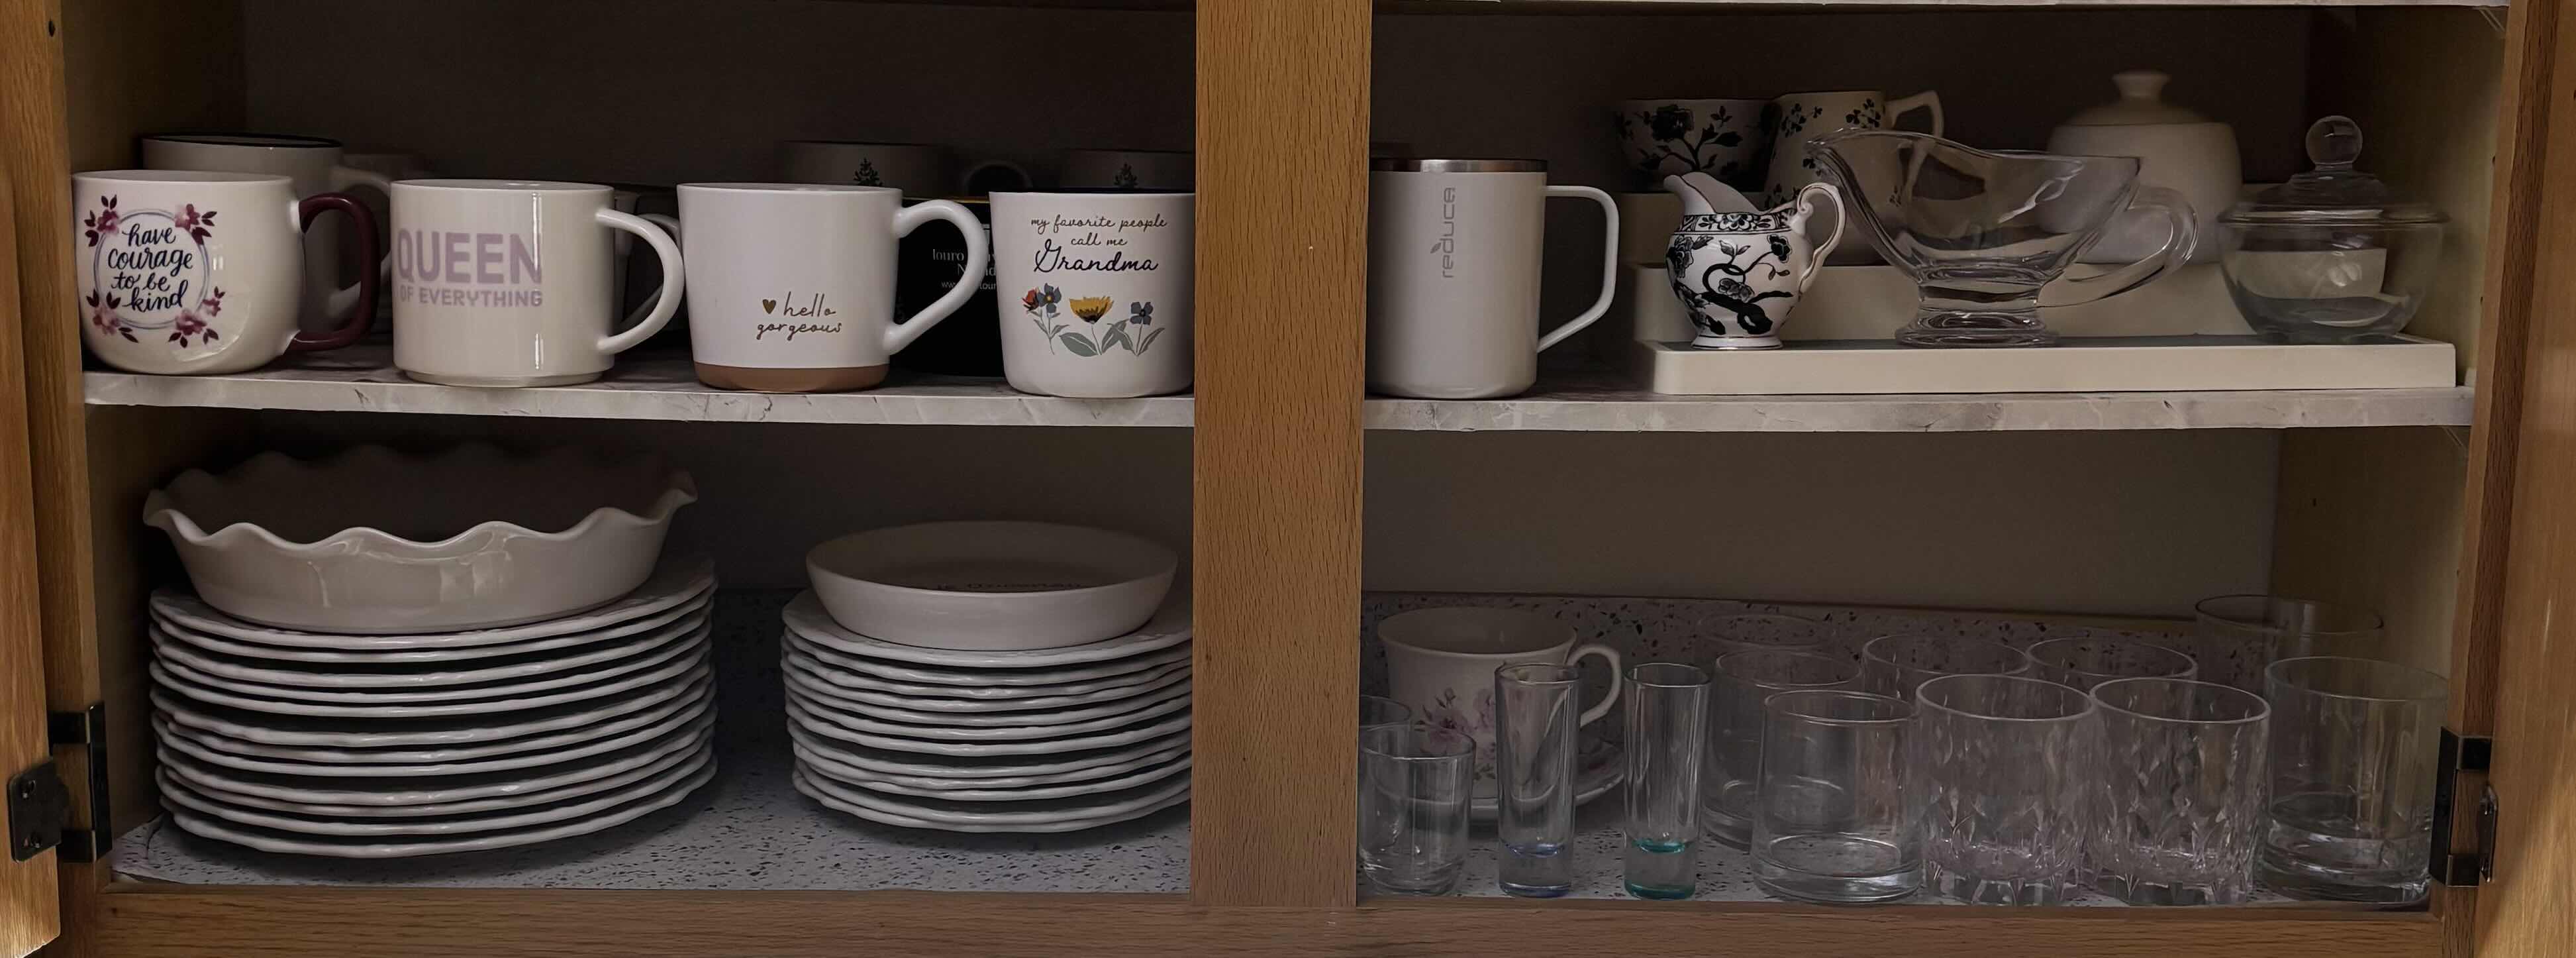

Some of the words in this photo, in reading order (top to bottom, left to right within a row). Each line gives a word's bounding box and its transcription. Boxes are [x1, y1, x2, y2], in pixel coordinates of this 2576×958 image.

[122, 223, 176, 246] have
[1031, 218, 1050, 235] my
[1054, 214, 1115, 233] favorite
[1119, 213, 1167, 232] people
[1438, 187, 1456, 278] reduce
[1071, 232, 1101, 246] call
[108, 247, 193, 276] courage
[397, 229, 542, 284] QUEEN
[1034, 239, 1159, 272] Grandma
[111, 271, 141, 290] to
[142, 272, 170, 292] be
[122, 280, 188, 313] kind
[400, 285, 413, 302] OF
[419, 287, 542, 308] EVERYTHING
[784, 291, 836, 317] hello
[756, 323, 842, 341] gorgeous
